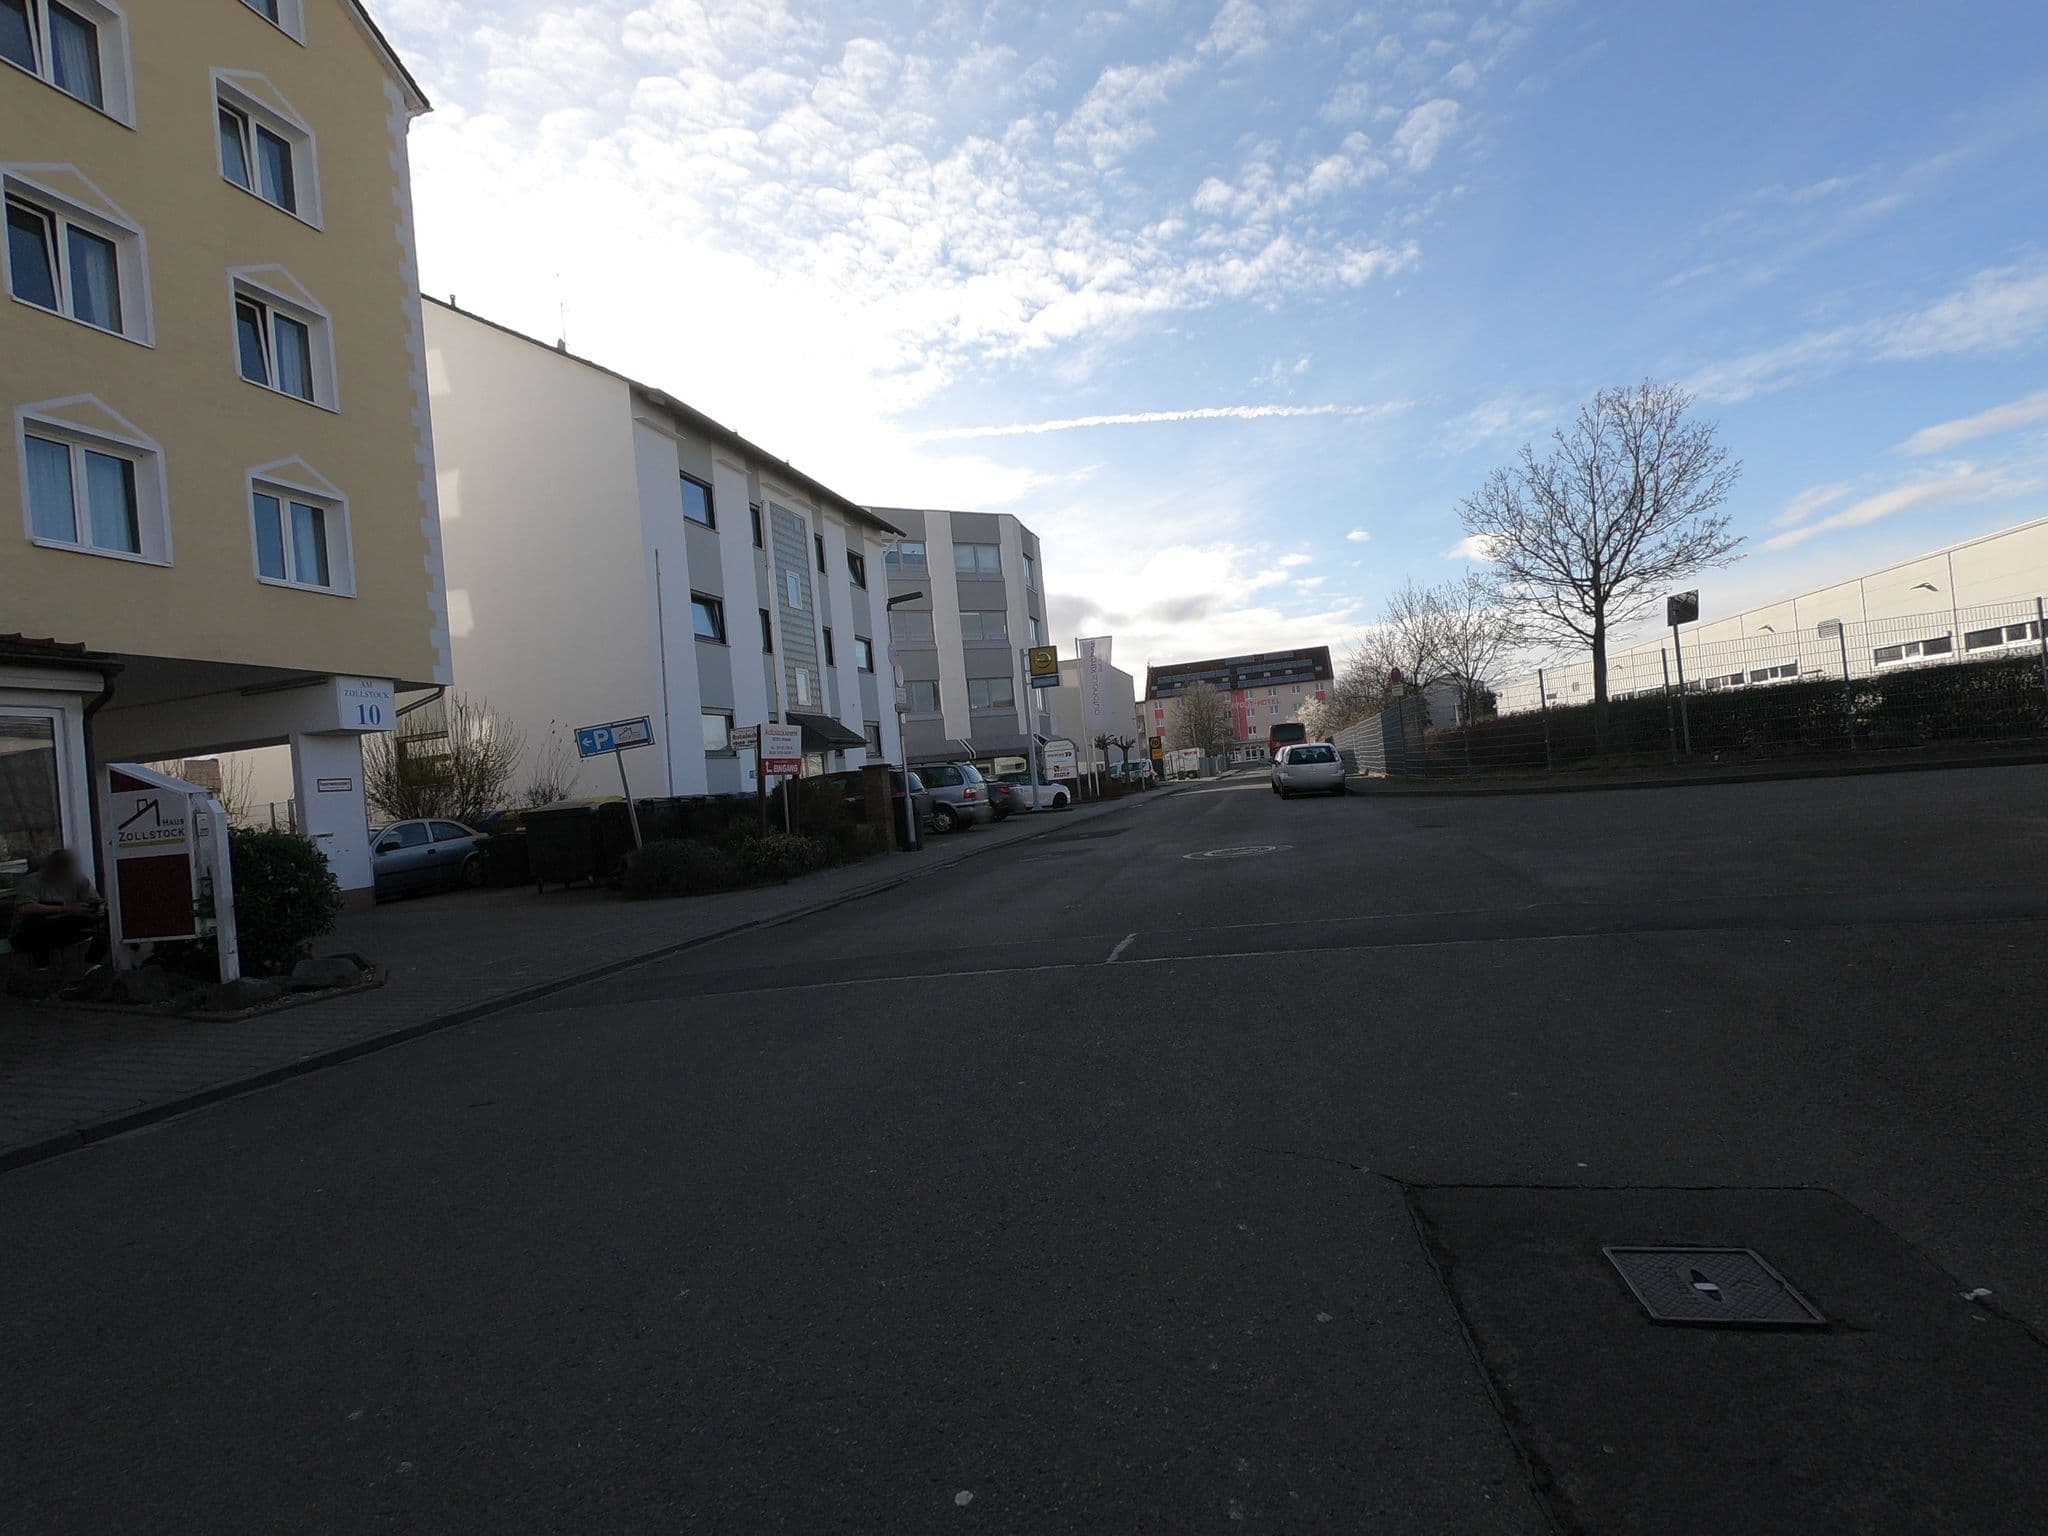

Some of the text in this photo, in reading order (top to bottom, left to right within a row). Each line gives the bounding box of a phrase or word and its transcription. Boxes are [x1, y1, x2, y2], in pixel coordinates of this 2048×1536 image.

[356, 703, 381, 726] 10
[773, 764, 798, 773] EINGANG
[162, 818, 184, 826] HAUS
[118, 827, 185, 842] ZOLLSTOCK
